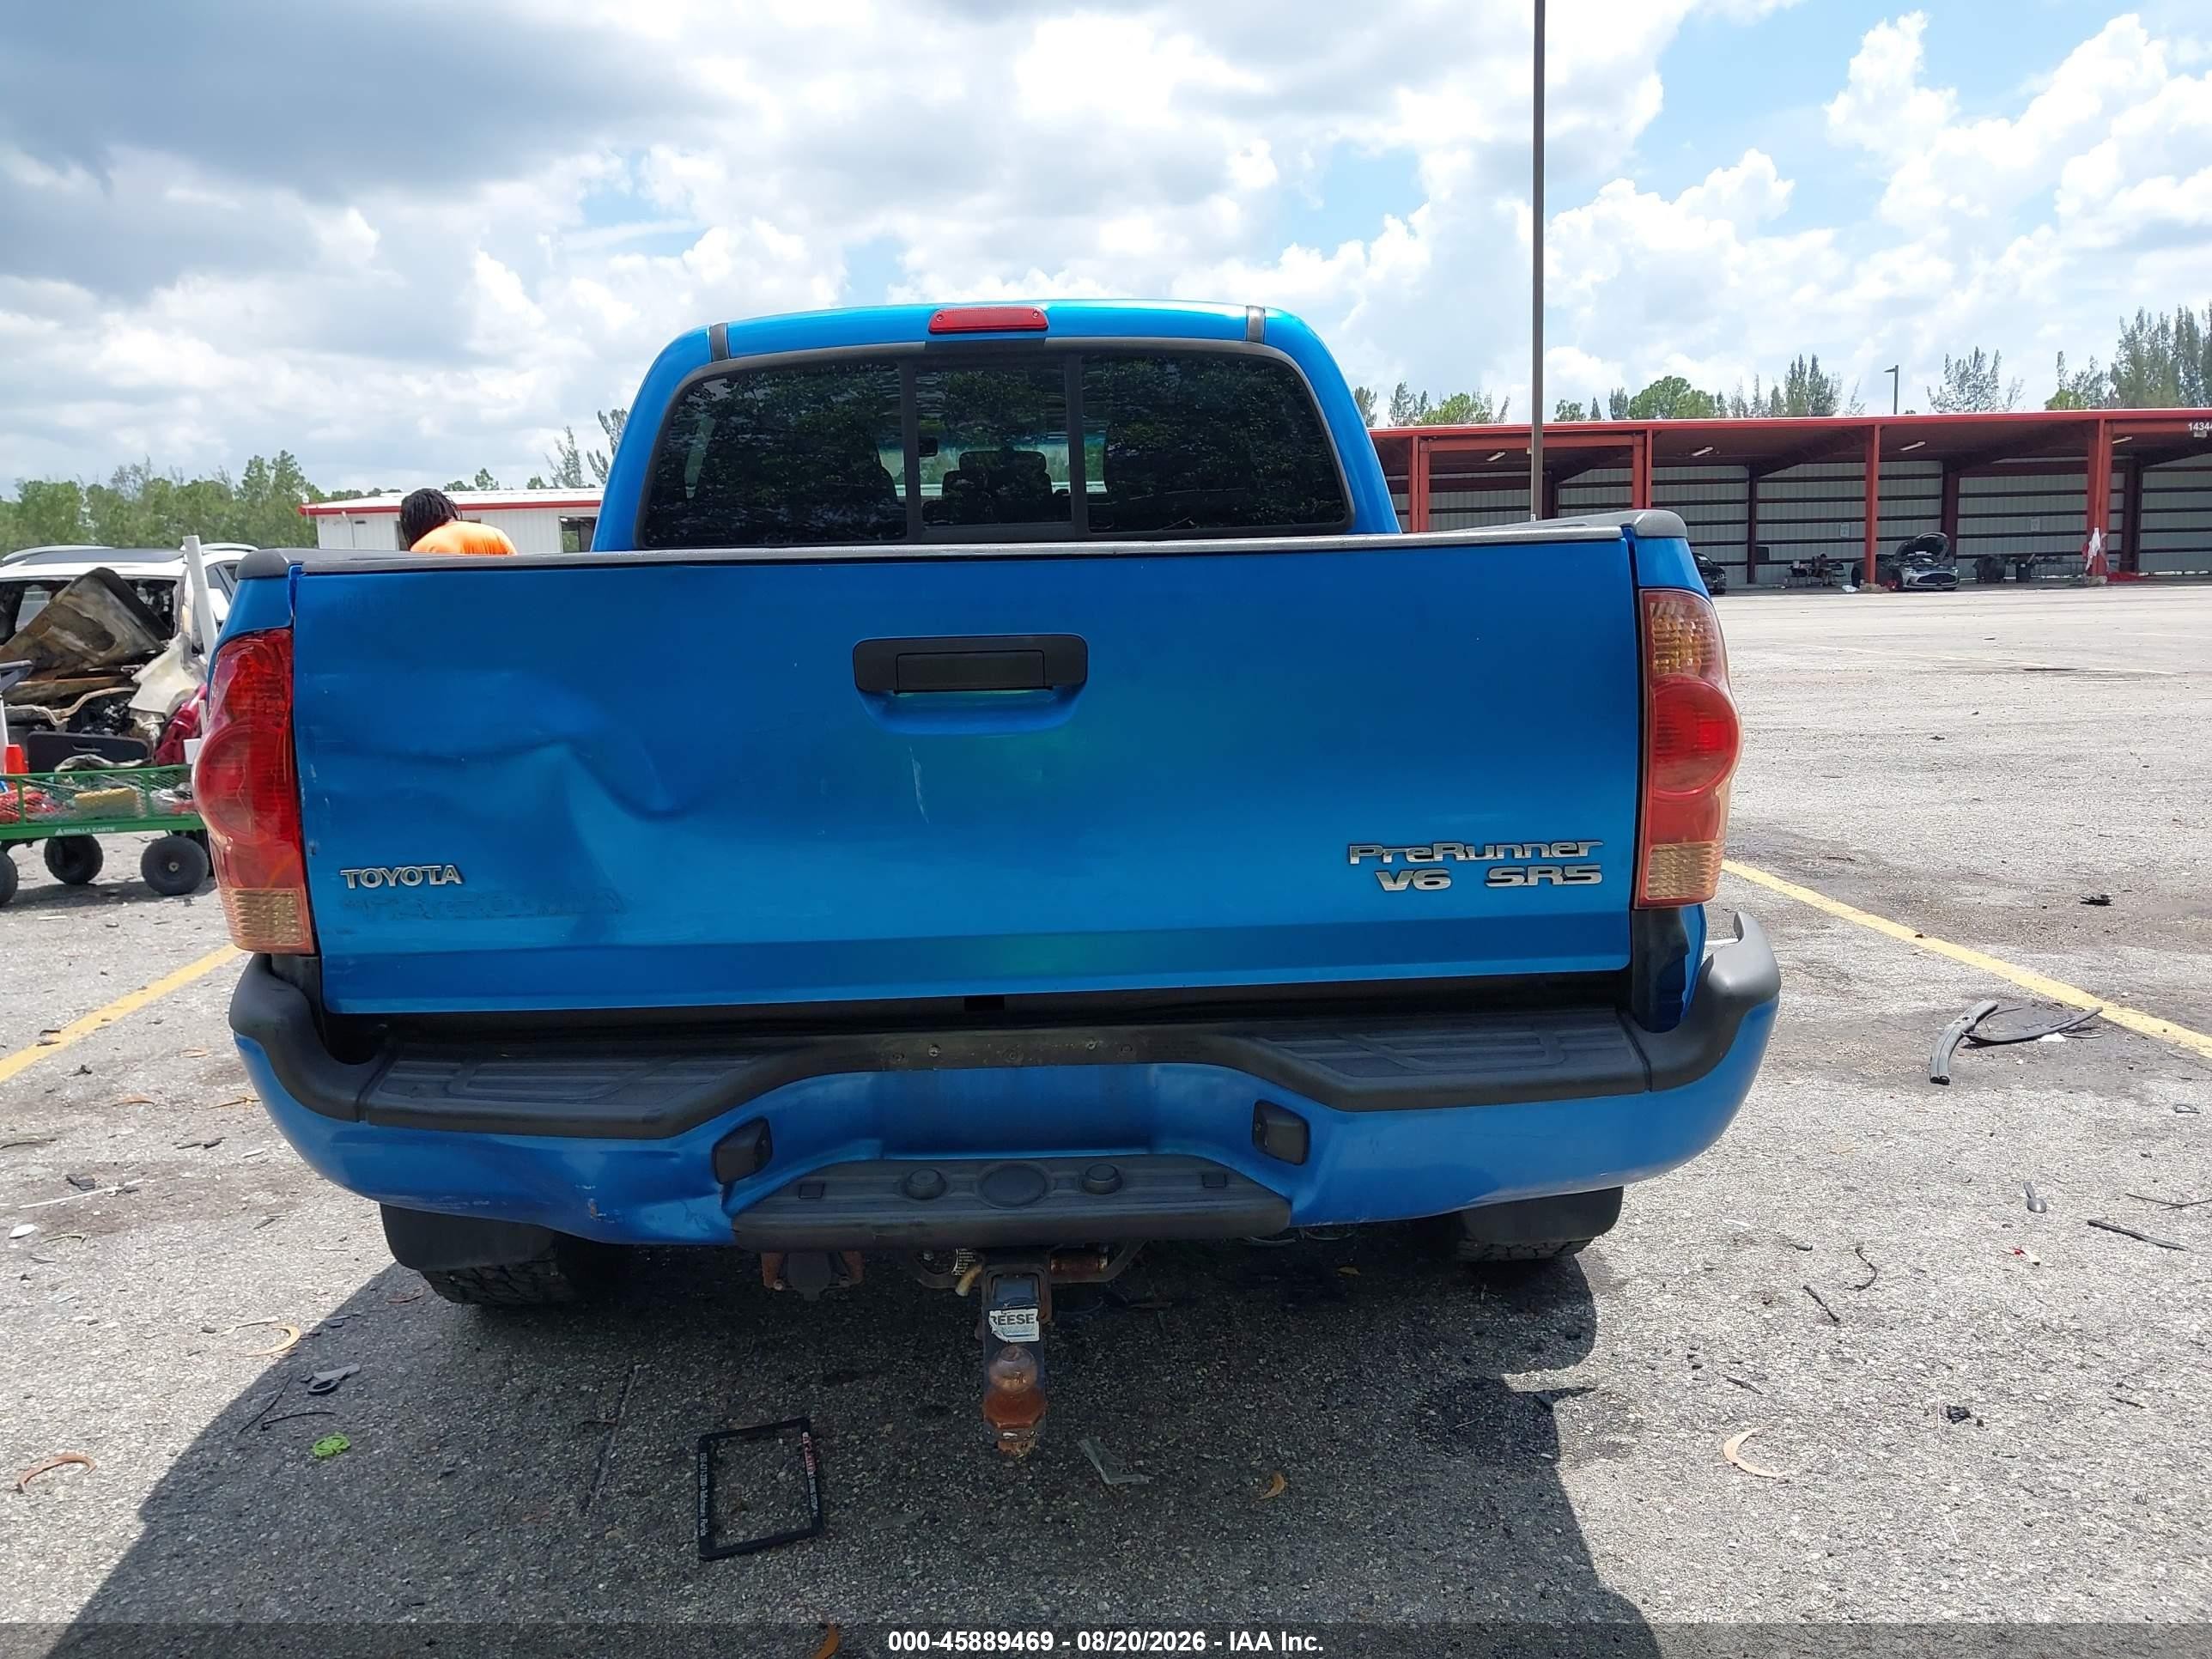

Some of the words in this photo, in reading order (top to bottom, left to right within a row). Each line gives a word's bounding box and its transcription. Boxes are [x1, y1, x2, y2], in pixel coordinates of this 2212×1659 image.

[1349, 841, 1603, 865] PreRunner
[340, 865, 463, 890] TOYOTA
[1375, 869, 1452, 891] V6
[1486, 864, 1603, 888] SR5
